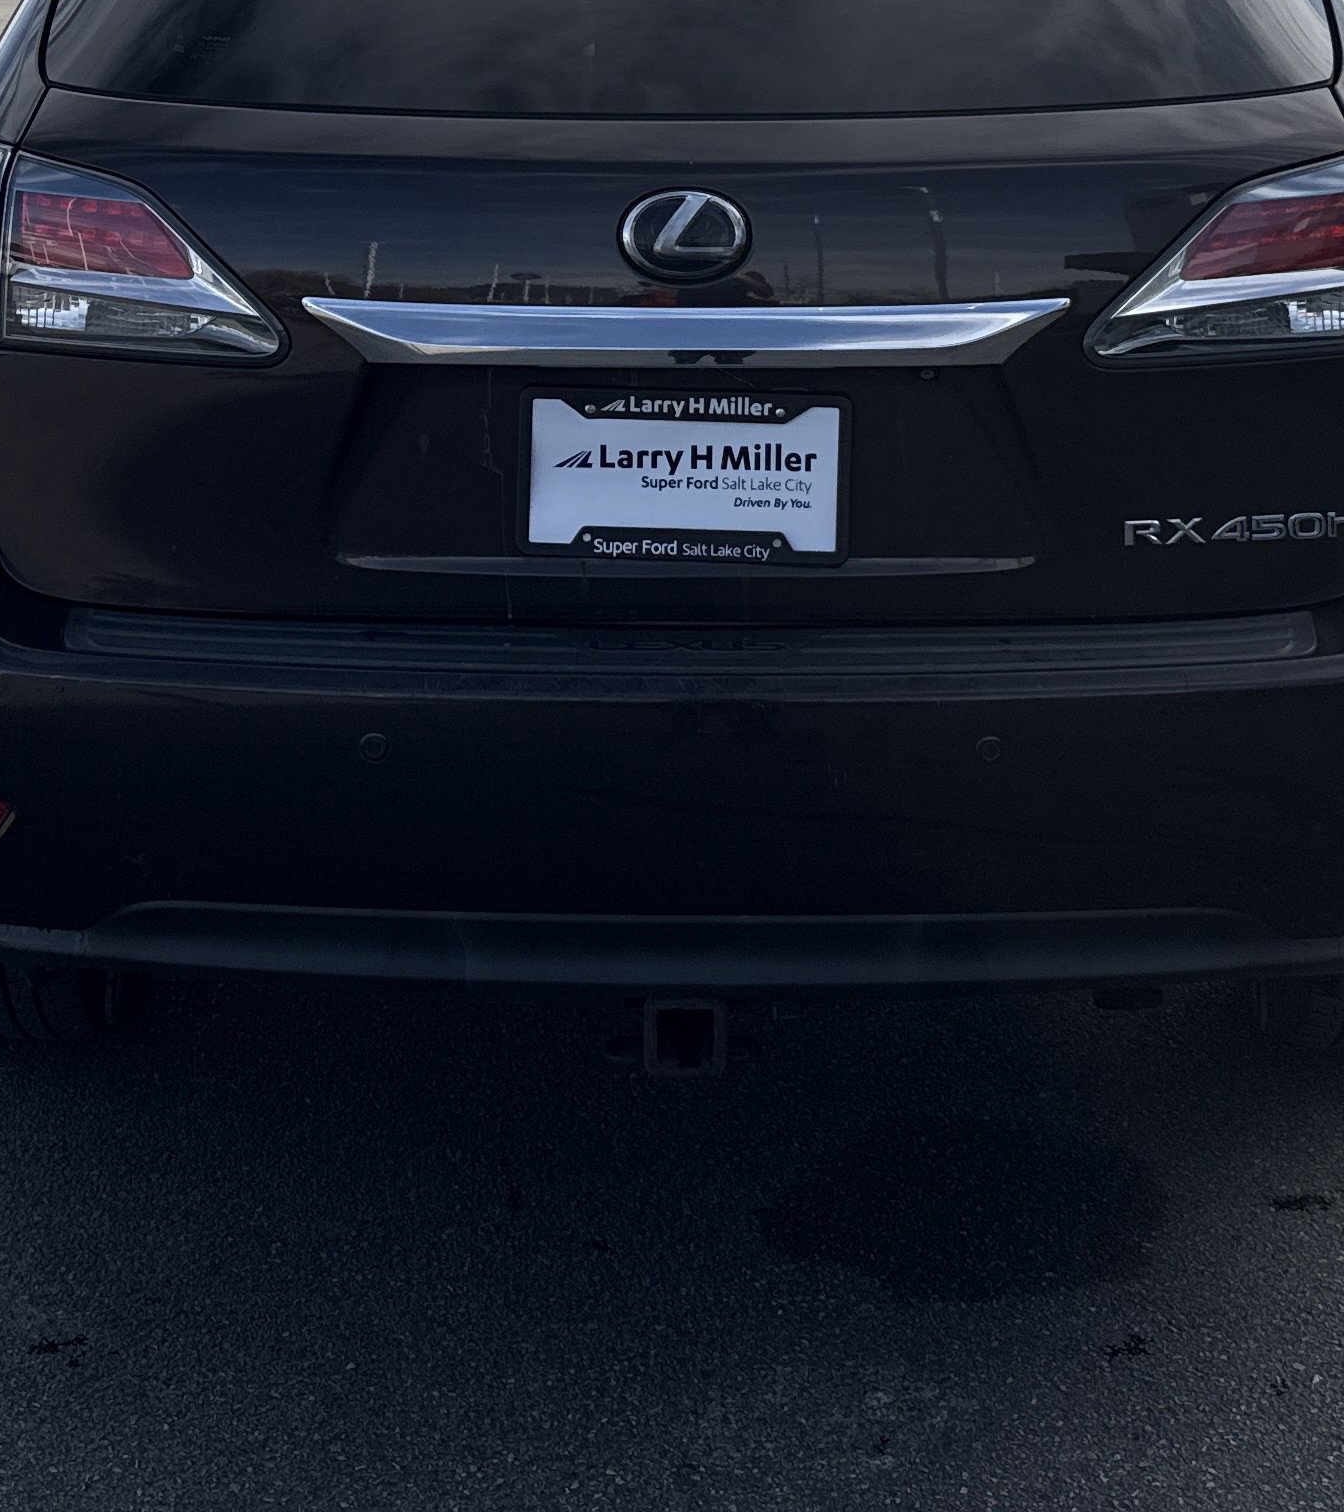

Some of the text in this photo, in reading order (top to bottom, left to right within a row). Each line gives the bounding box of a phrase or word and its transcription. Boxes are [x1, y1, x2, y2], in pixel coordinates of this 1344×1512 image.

[629, 395, 773, 418] Larry H Miller
[599, 443, 817, 475] Larry H Miller
[641, 475, 812, 494] Super Ford Salt Lake City
[733, 496, 771, 508] Driven
[773, 498, 788, 510] By
[1123, 517, 1207, 546] RX
[593, 538, 770, 561] Super Ford Salt Lake City
